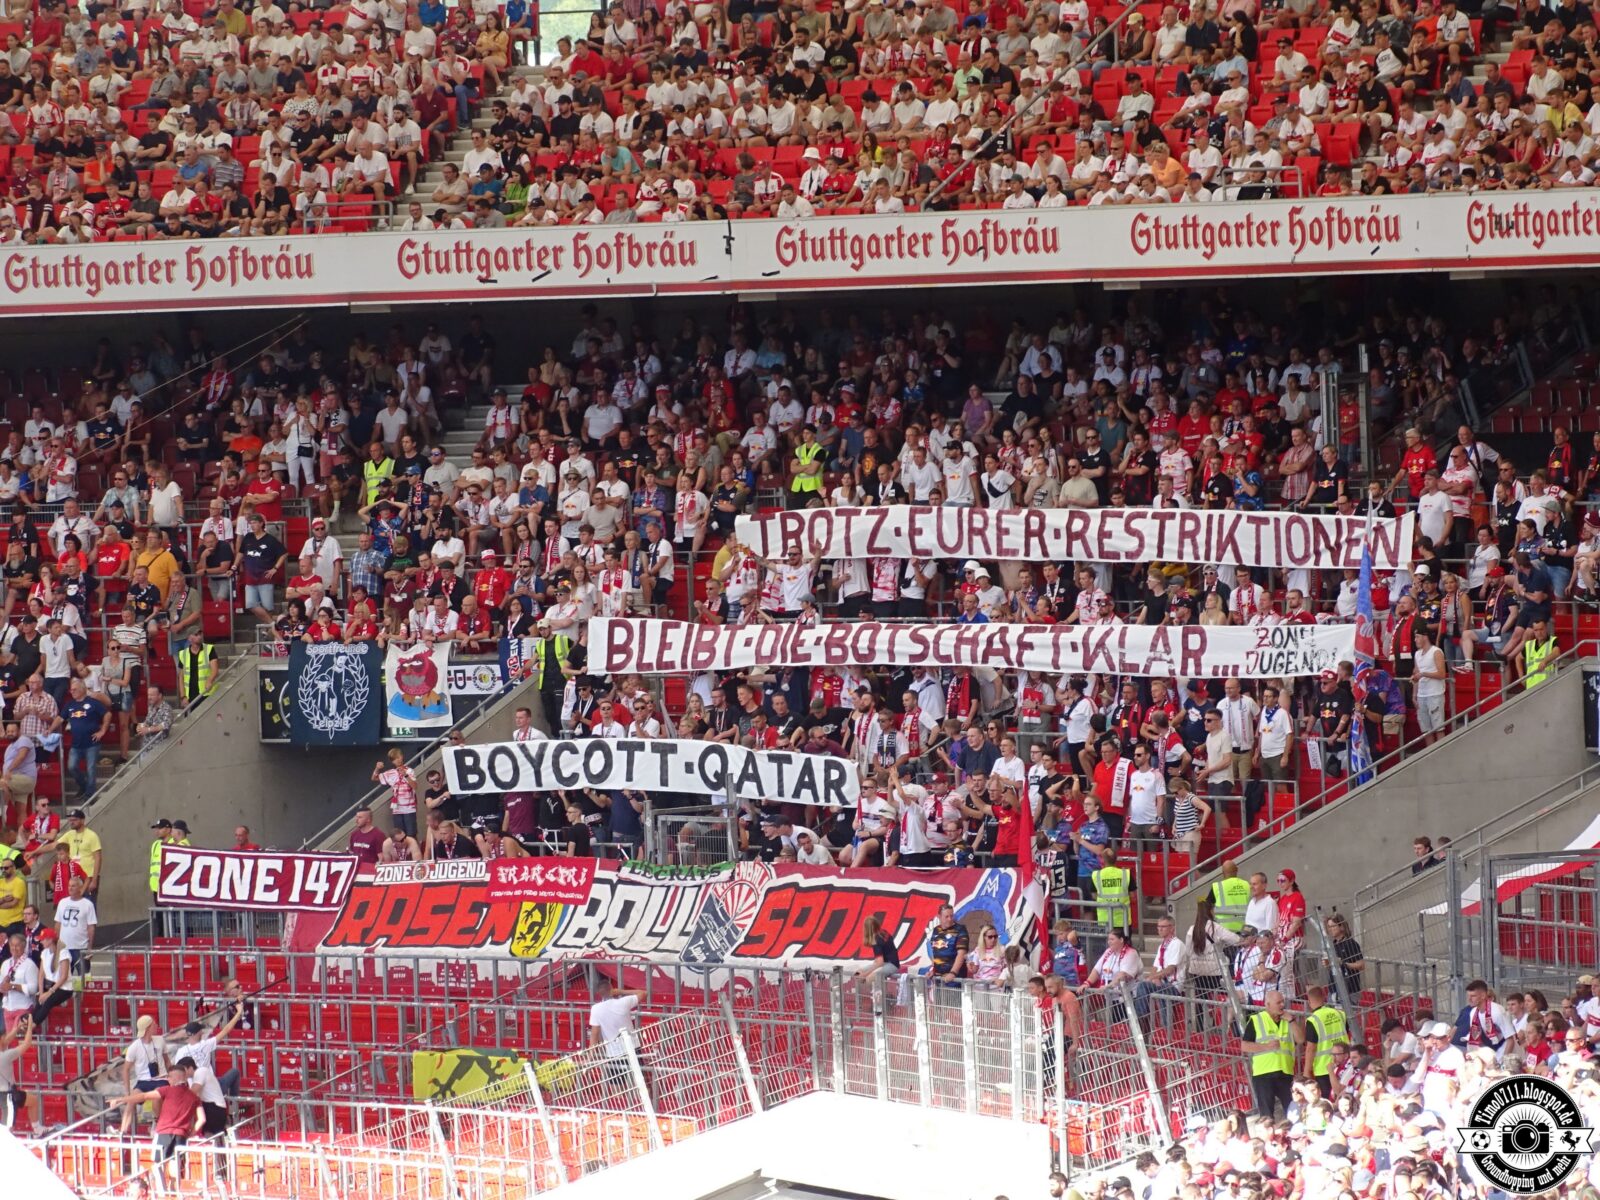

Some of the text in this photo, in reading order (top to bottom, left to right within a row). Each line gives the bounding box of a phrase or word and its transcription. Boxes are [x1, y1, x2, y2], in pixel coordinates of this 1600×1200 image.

[397, 230, 698, 281] Stuttgarter Hofbräu
[775, 216, 1060, 272] Stuttgarter Hofbräu
[1130, 204, 1402, 261] Stuttgarter Hofbräu
[4, 243, 315, 298] Stuttgarter Hofbräu
[1065, 509, 1400, 568] RESTRIKTIONEN
[305, 642, 369, 655] Sportfreunde
[313, 717, 350, 731] Leipzig
[454, 740, 849, 806] BOYCOTT QATAR
[161, 852, 353, 905] ZONE 147
[375, 861, 486, 883] ZONE JUGEND
[326, 881, 949, 960] RASEN BALL SPORT
